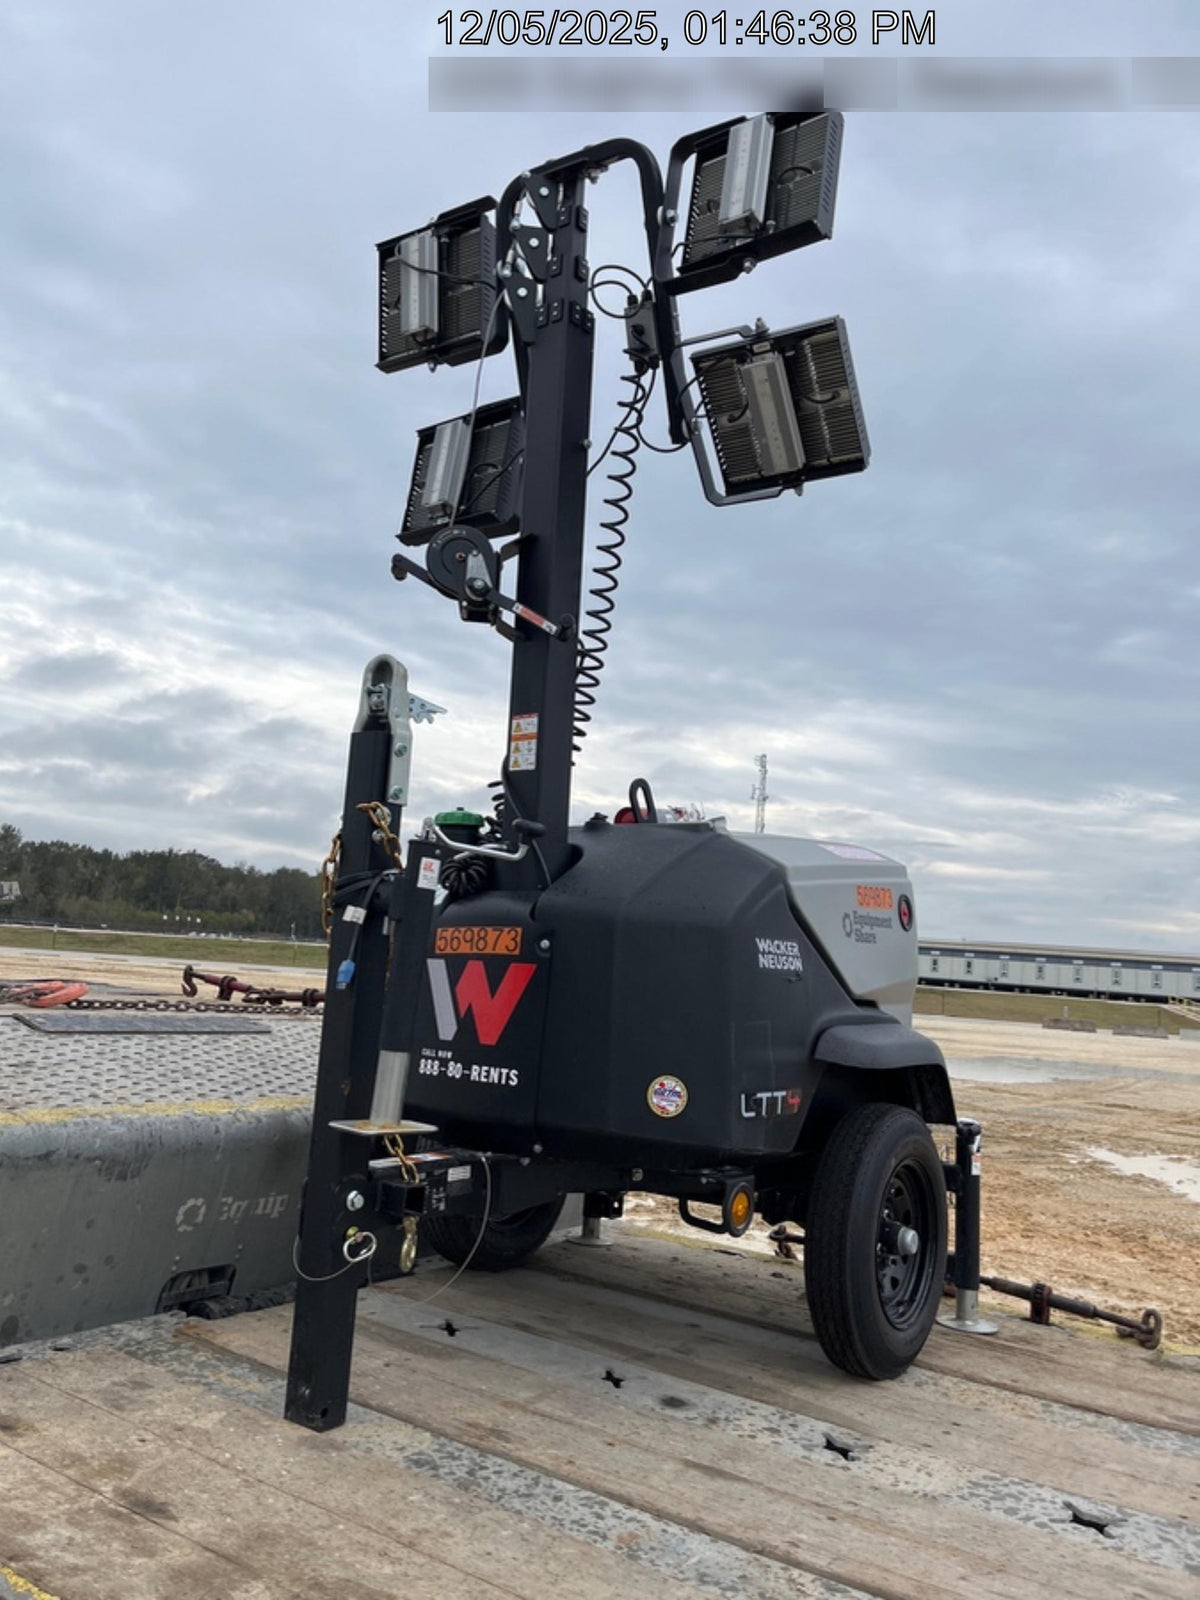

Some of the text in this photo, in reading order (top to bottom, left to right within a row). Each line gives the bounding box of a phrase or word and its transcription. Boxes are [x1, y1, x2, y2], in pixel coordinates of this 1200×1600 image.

[437, 927, 520, 952] 569873
[756, 937, 800, 957] WACKER
[758, 954, 803, 971] NEUSON
[418, 1058, 519, 1086] 888-80-RENTS
[740, 1089, 801, 1118] LTT4
